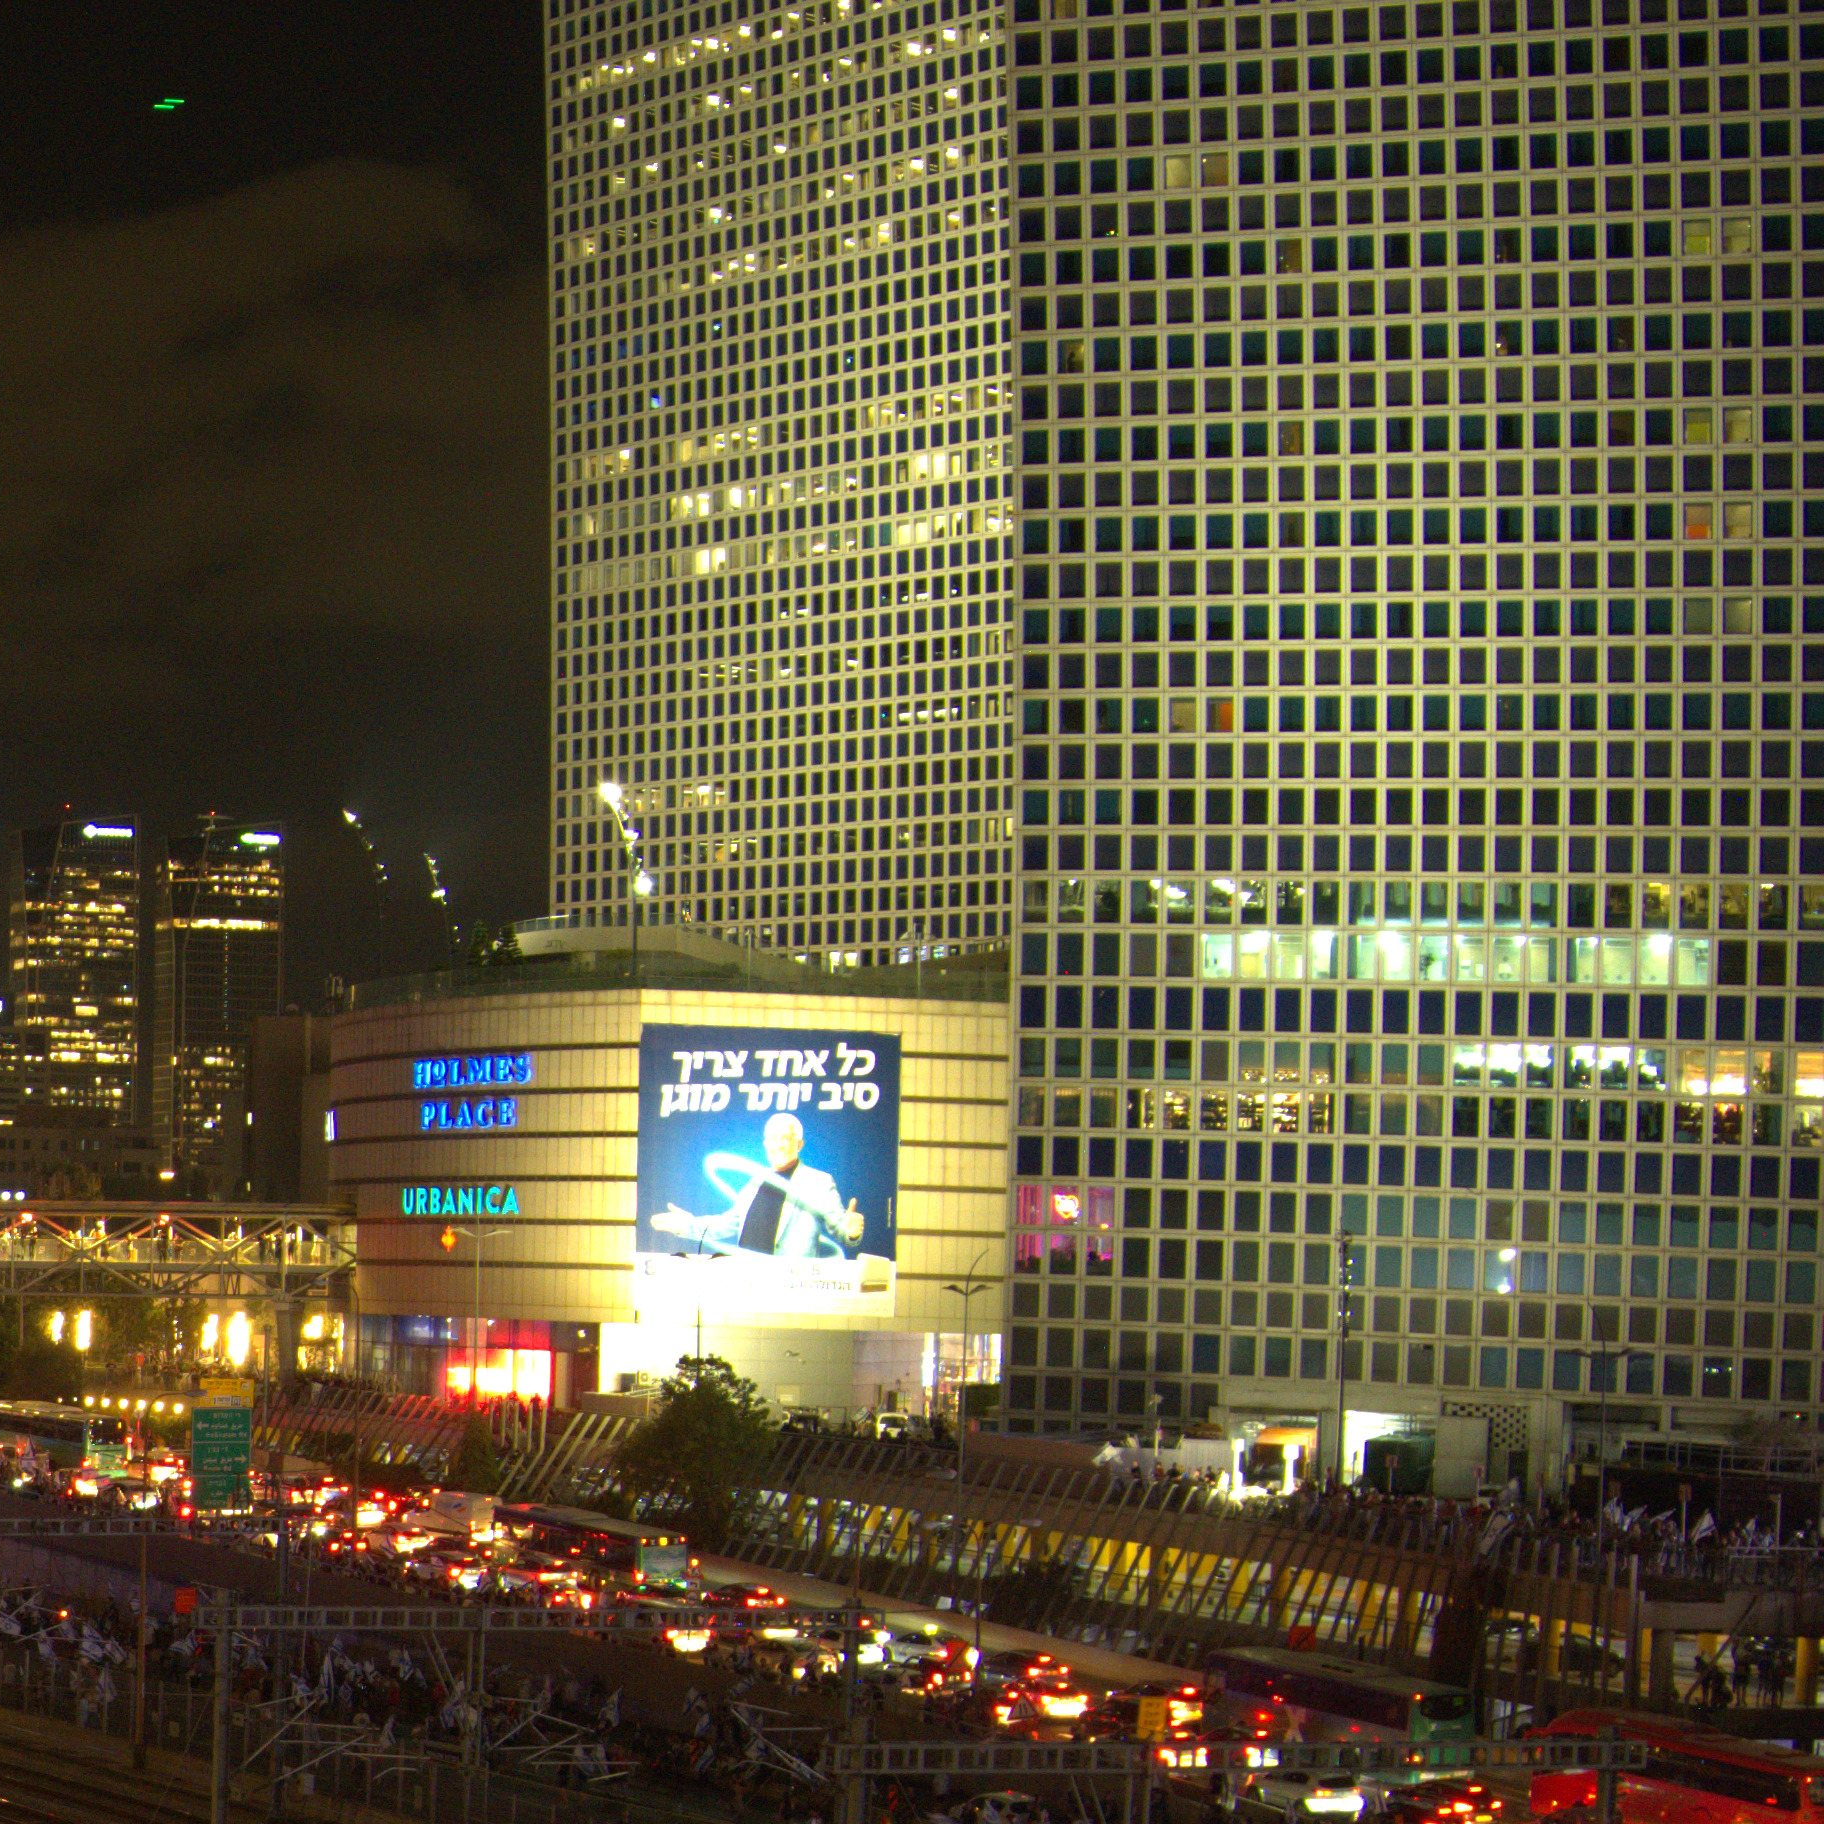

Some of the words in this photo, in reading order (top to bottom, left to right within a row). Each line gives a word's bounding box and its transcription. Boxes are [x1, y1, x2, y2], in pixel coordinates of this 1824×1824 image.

[413, 1054, 533, 1089] HOLMES
[673, 1050, 748, 1083] צריך
[755, 1049, 829, 1077] אחד
[836, 1042, 876, 1077] כל
[660, 1083, 731, 1117] מוגן
[739, 1082, 812, 1111] יותר
[818, 1082, 880, 1110] סיב
[420, 1098, 518, 1130] PLACE
[403, 1186, 519, 1215] URBANICA
